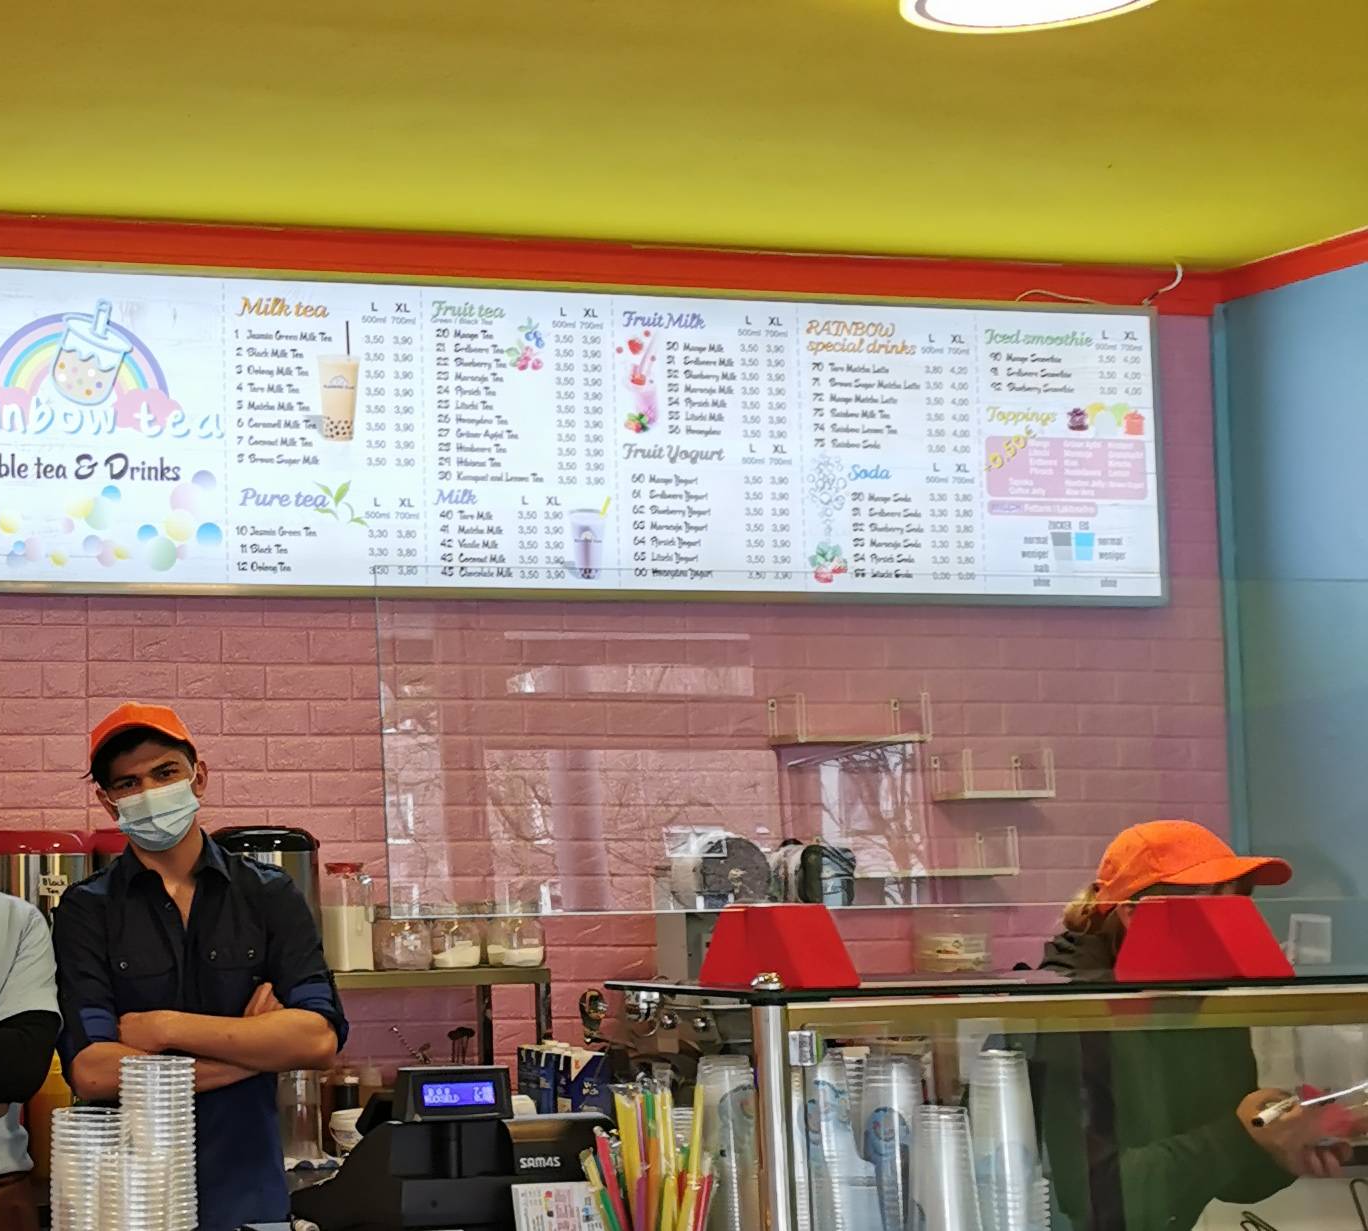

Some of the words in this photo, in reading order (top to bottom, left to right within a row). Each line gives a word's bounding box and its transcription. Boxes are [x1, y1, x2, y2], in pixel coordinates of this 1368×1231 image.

[235, 296, 292, 317] Milk
[294, 302, 330, 318] tea
[370, 302, 378, 312] L
[395, 303, 411, 313] XL
[431, 300, 476, 319] Fruit
[477, 305, 506, 319] tea
[560, 308, 567, 317] L
[584, 308, 598, 318] XL
[622, 310, 665, 328] Fruit
[664, 313, 706, 330] Milk
[745, 316, 752, 325] L
[768, 316, 783, 326] XL
[435, 329, 450, 338] 20
[480, 330, 494, 340] Tea
[806, 320, 896, 338] RAINBOW
[234, 330, 239, 339] 1
[299, 332, 318, 341] Milk
[318, 332, 332, 342] Tea
[928, 334, 935, 343] L
[951, 334, 965, 344] XL
[985, 328, 1021, 345] Iced
[1023, 330, 1094, 347] smoothie
[1101, 330, 1109, 339] L
[1123, 331, 1138, 341] XL
[708, 344, 725, 353] Milk
[806, 337, 864, 356] special
[866, 340, 917, 356] drinks
[270, 348, 289, 358] Milk
[289, 348, 304, 358] Tea
[276, 366, 293, 376] Milk
[295, 366, 309, 377] Tea
[236, 383, 243, 392] 4
[266, 384, 284, 394] Milk
[286, 384, 300, 394] Tea
[277, 402, 295, 411] Milk
[297, 402, 311, 412] Tea
[986, 404, 1058, 426] Toppings
[132, 403, 225, 440] tea
[236, 436, 244, 445] 7
[280, 437, 298, 447] Milk
[299, 437, 313, 447] Tea
[622, 443, 665, 460] Fruit
[666, 444, 726, 464] Yogurt
[749, 444, 756, 453] L
[773, 445, 787, 454] XL
[302, 455, 320, 465] Milk
[35, 456, 67, 479] tea
[74, 454, 99, 480] &
[104, 453, 181, 482] Drinks
[848, 464, 892, 481] Soda
[932, 463, 940, 472] L
[955, 464, 970, 473] XL
[239, 487, 291, 507] Pure
[294, 491, 330, 508] tea
[434, 488, 478, 506] Milk
[522, 496, 528, 505] L
[546, 496, 561, 506] XL
[373, 498, 381, 507] L
[399, 498, 414, 508] XL
[476, 511, 494, 520] Milk
[235, 525, 248, 536] 10
[303, 526, 317, 537] Tea
[486, 526, 504, 535] Milk
[249, 544, 272, 554] Black
[274, 544, 288, 554] Tea
[489, 554, 506, 563] Milk
[236, 562, 248, 572] 12
[277, 562, 291, 572] Tea
[42, 877, 64, 887] Black
